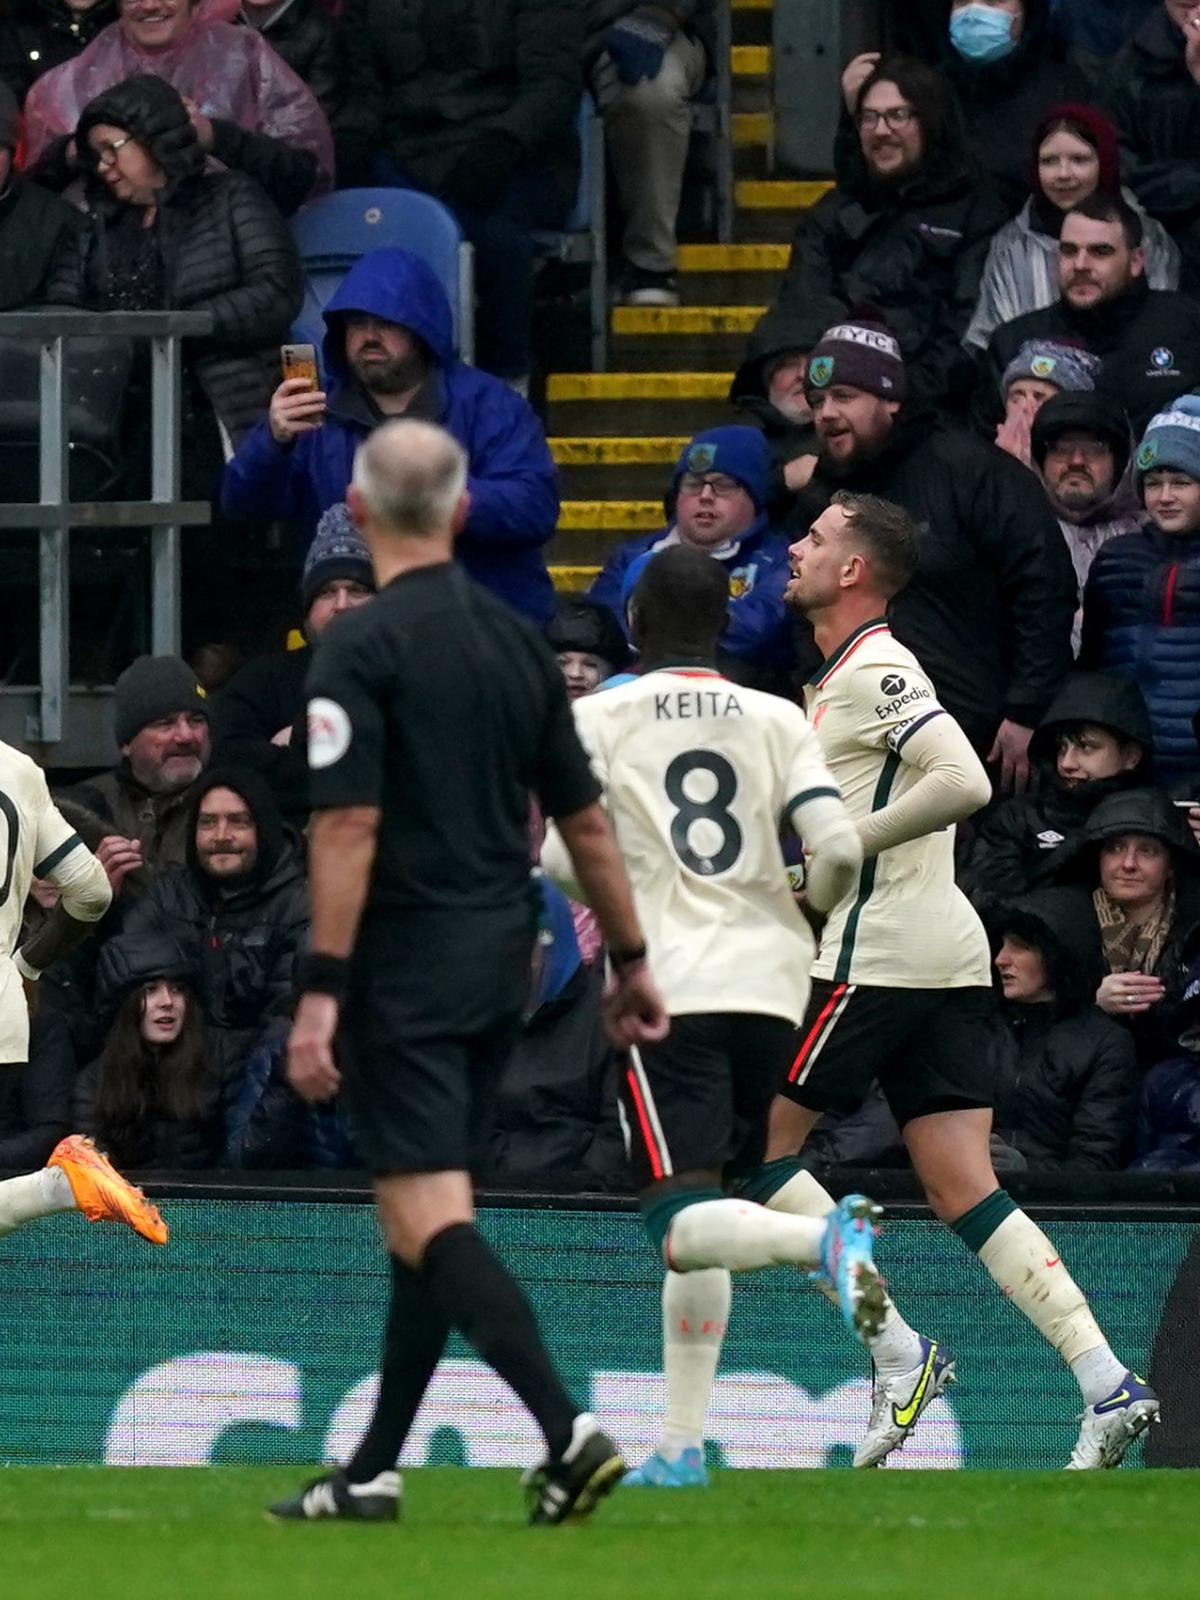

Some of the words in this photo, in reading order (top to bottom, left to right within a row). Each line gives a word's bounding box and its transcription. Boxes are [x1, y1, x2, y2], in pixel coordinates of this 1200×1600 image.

[654, 691, 744, 720] KEITA
[875, 686, 931, 720] Expedia
[664, 749, 743, 876] 8
